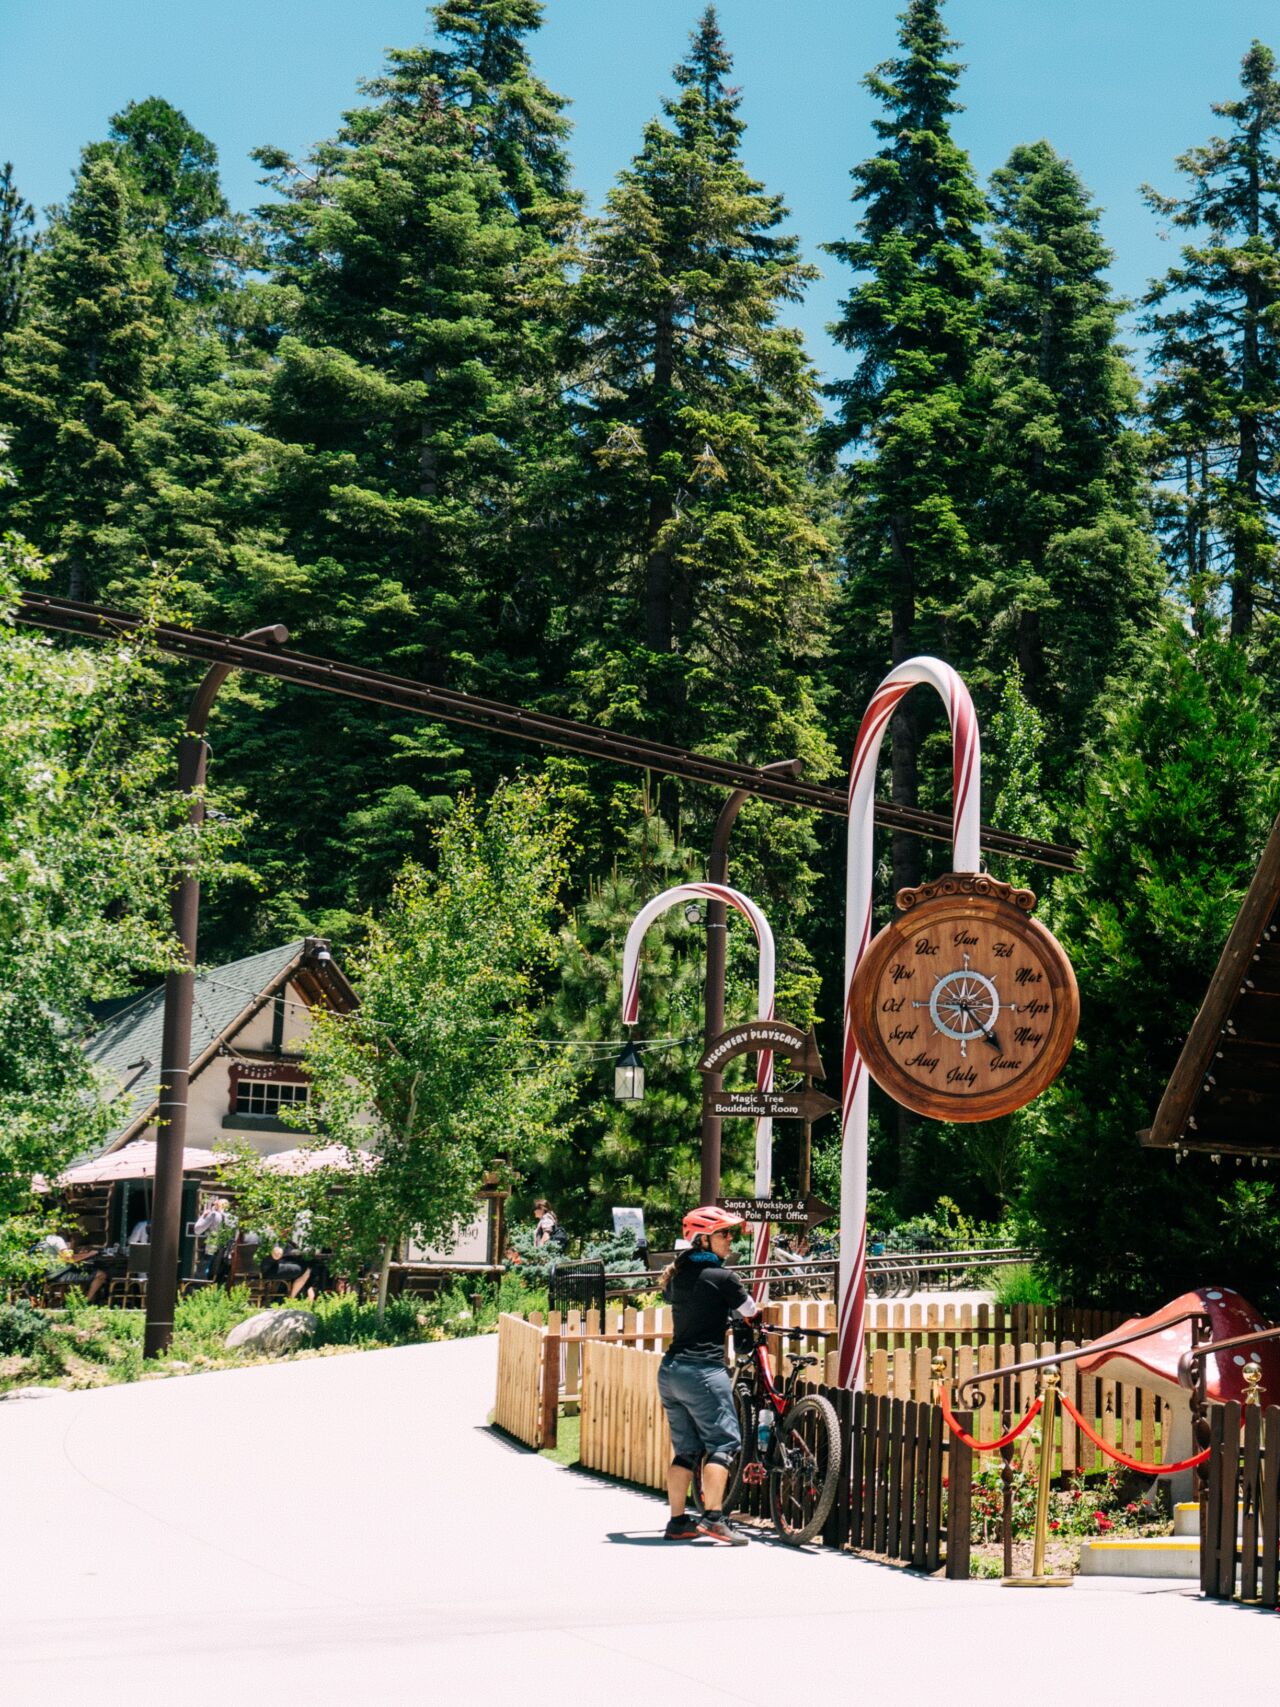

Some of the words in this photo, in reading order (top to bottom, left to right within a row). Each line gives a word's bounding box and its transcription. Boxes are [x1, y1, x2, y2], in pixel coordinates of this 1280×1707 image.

[915, 938, 940, 955] Dec
[953, 930, 979, 949] Jan
[992, 942, 1015, 958] Feb
[888, 964, 916, 985] Nov
[1015, 967, 1043, 985] Mar
[882, 997, 905, 1013] Oct
[1016, 1001, 1051, 1019] Apr
[888, 1023, 919, 1045] Sept
[1014, 1026, 1044, 1048] May
[703, 1032, 748, 1069] DISCOVERY
[750, 1031, 803, 1049] PLAYSCAPE
[904, 1052, 940, 1074] Aug
[989, 1053, 1022, 1072] June
[946, 1066, 978, 1088] July
[730, 1094, 758, 1105] Magic
[763, 1094, 784, 1103] Tree
[715, 1104, 766, 1115] Bouldering
[770, 1104, 799, 1114] Room
[724, 1199, 752, 1210] Santa's
[755, 1201, 793, 1211] Workshop
[796, 1201, 805, 1210] &
[745, 1210, 762, 1219] Pole
[765, 1210, 782, 1220] Post
[786, 1211, 809, 1220] Office
